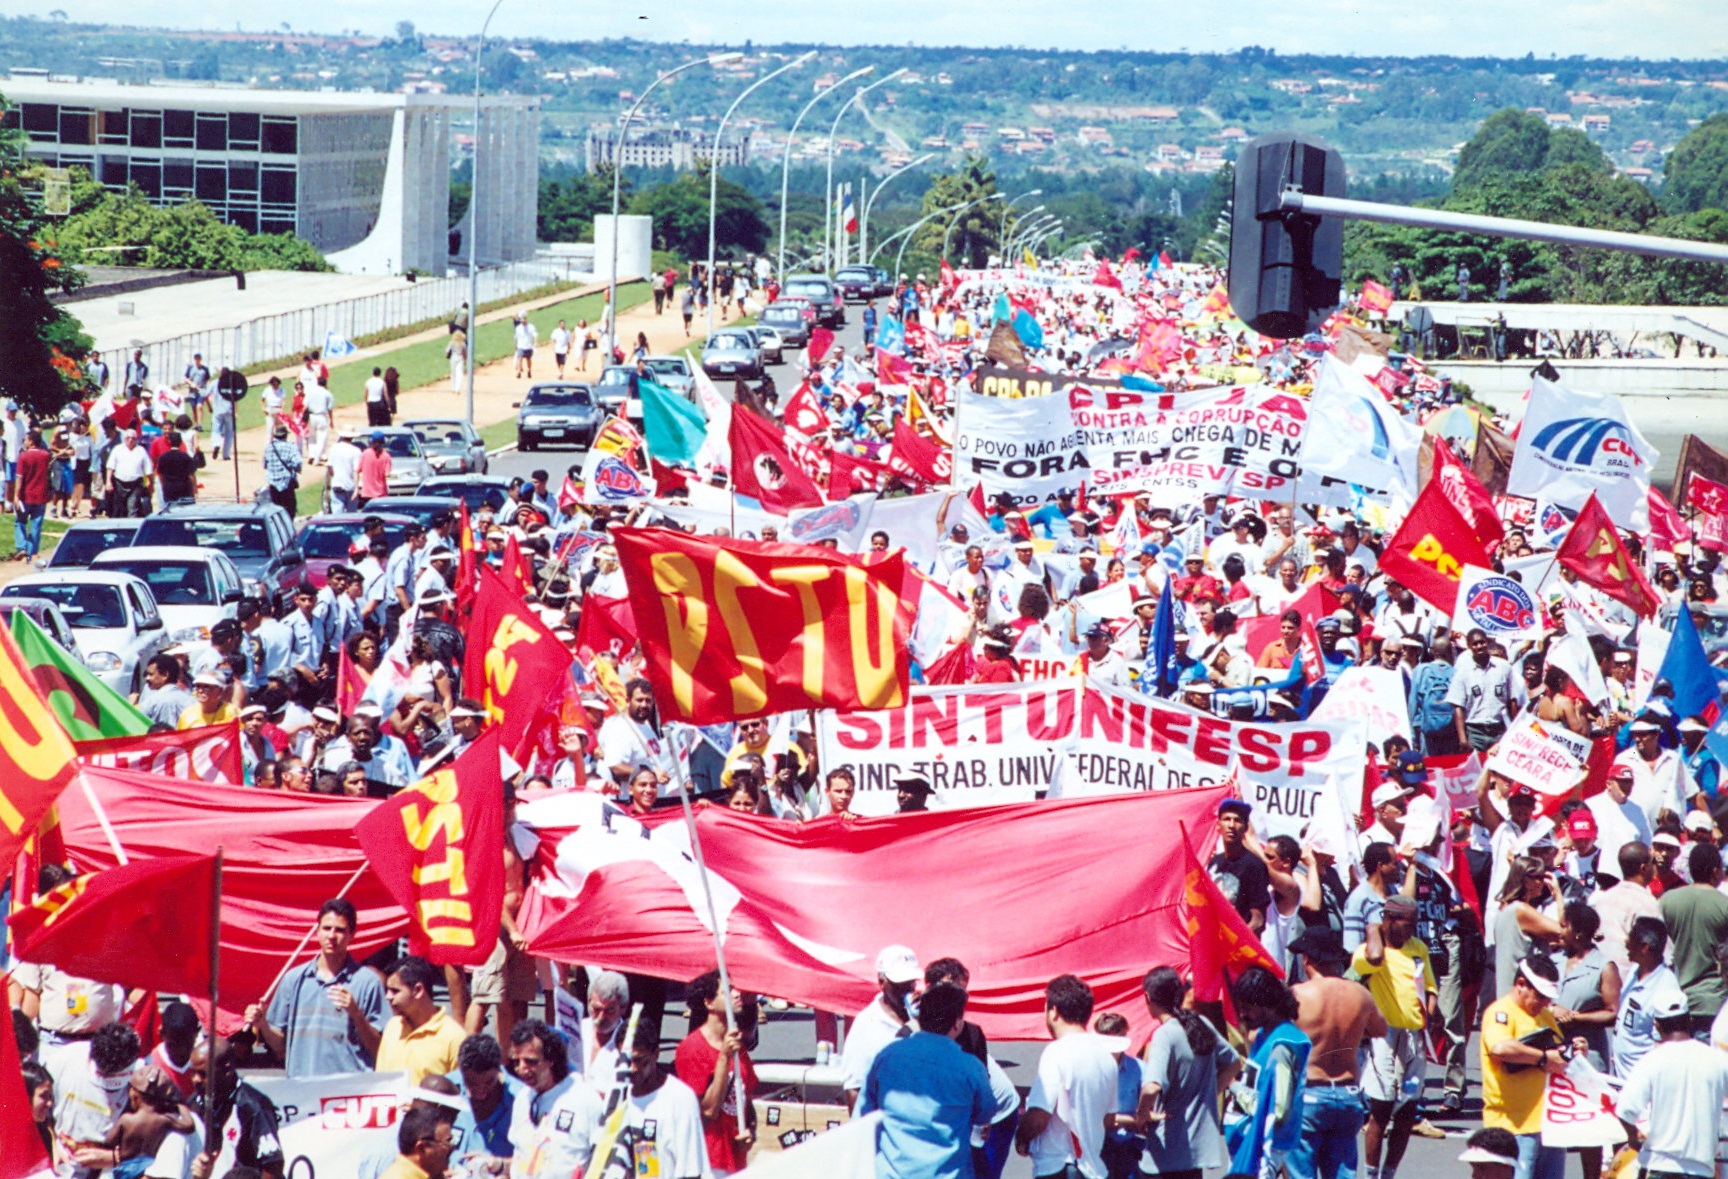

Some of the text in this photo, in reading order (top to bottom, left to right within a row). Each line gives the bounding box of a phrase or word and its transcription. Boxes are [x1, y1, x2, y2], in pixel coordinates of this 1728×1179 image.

[1068, 386, 1175, 411] CPI
[1175, 407, 1301, 437] CORRUPÇÃO
[959, 435, 969, 450] O
[975, 437, 1017, 458] POVO
[1025, 439, 1055, 458] NÃO
[1060, 430, 1115, 452] AGENTA
[1122, 430, 1159, 446] MAIS
[1171, 425, 1235, 444] CHEGA
[1244, 429, 1273, 452] DE
[971, 450, 1091, 479] FORA
[1113, 446, 1200, 469] FHC
[1222, 447, 1249, 468] E
[1466, 589, 1536, 630] ABC
[651, 549, 905, 718] PSTU
[1505, 750, 1556, 785] CEARÁ
[398, 768, 476, 947] PSTU
[322, 1095, 397, 1130] CUT
